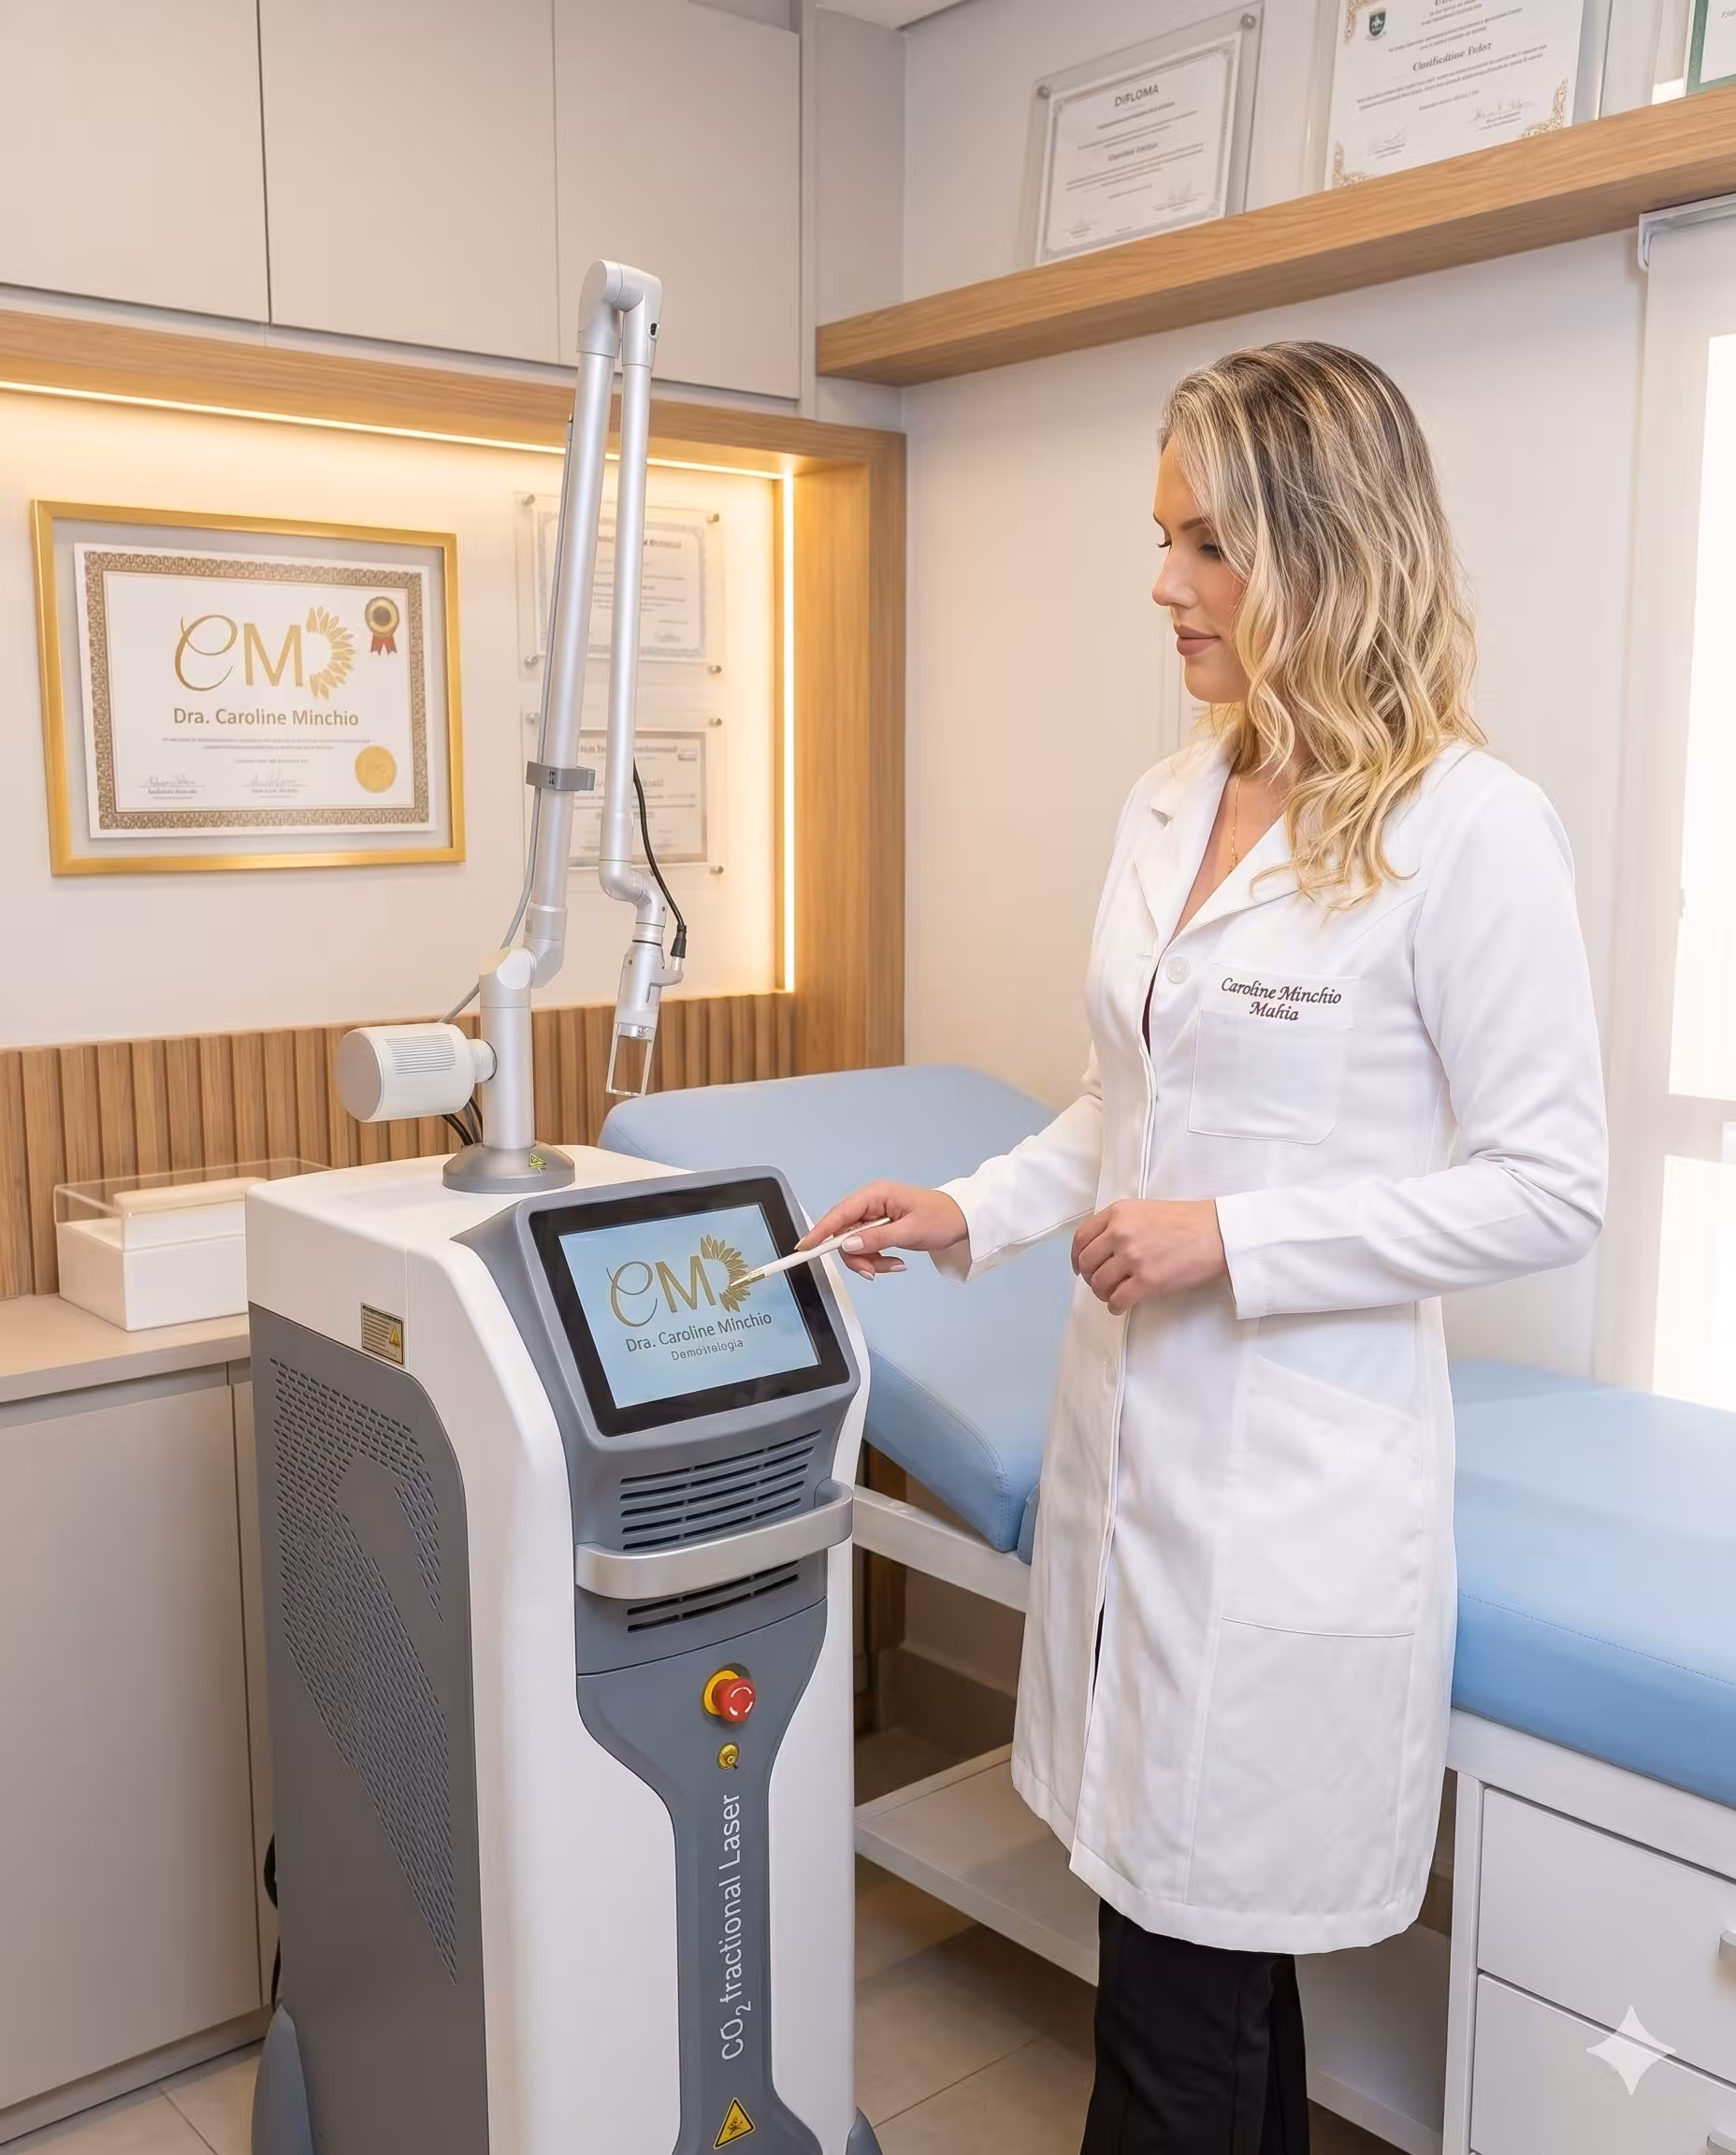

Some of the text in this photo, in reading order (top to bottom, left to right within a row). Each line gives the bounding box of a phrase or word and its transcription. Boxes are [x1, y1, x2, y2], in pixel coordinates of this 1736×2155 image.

[173, 707, 360, 727] Dra. Caroline Minchio
[1221, 977, 1342, 1005] Caroline Minchio
[625, 1312, 773, 1352] Dra. Caroline Minchio
[717, 1793, 742, 1871] Laser
[718, 1874, 743, 2003] fractional
